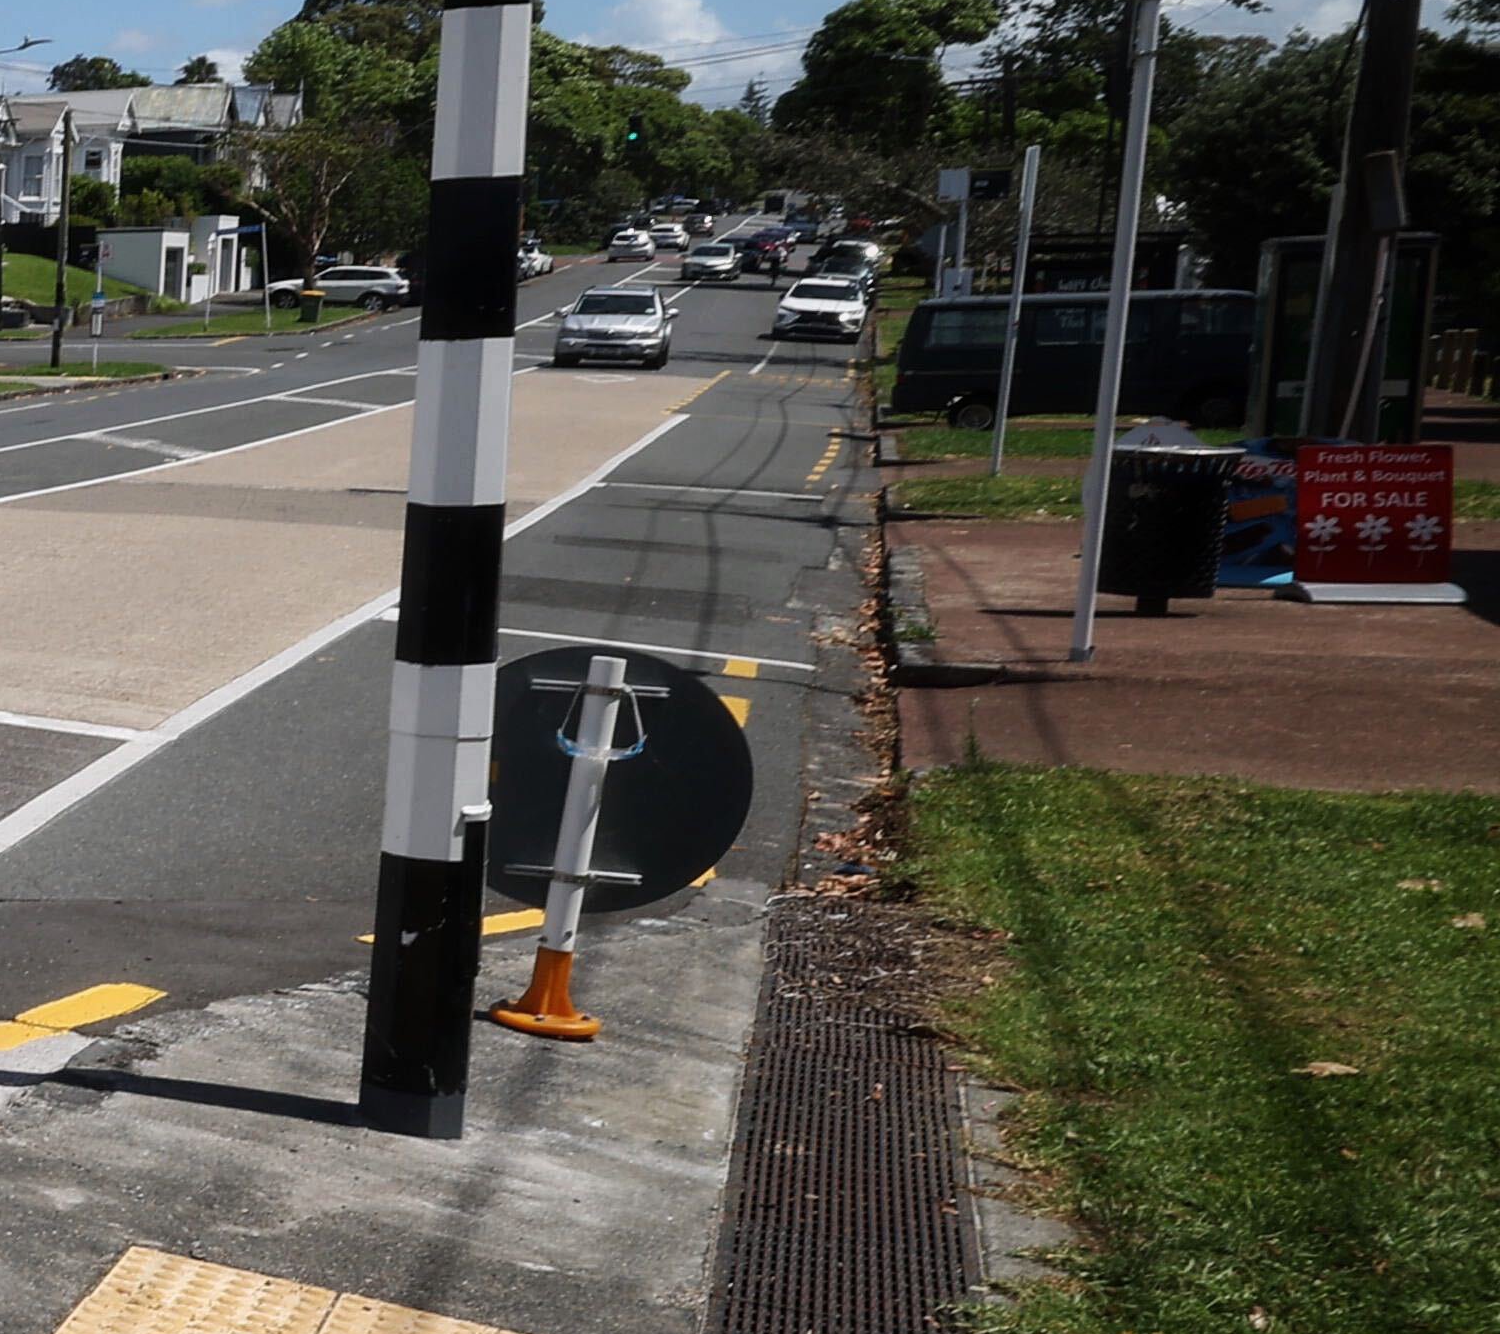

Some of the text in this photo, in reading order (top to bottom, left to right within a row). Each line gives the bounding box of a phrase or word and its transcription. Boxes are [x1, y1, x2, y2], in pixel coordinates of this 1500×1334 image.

[1318, 451, 1432, 465] Fresh Flower,
[1304, 470, 1445, 484] Plant & Bouquet
[1321, 491, 1429, 508] FOR SALE
